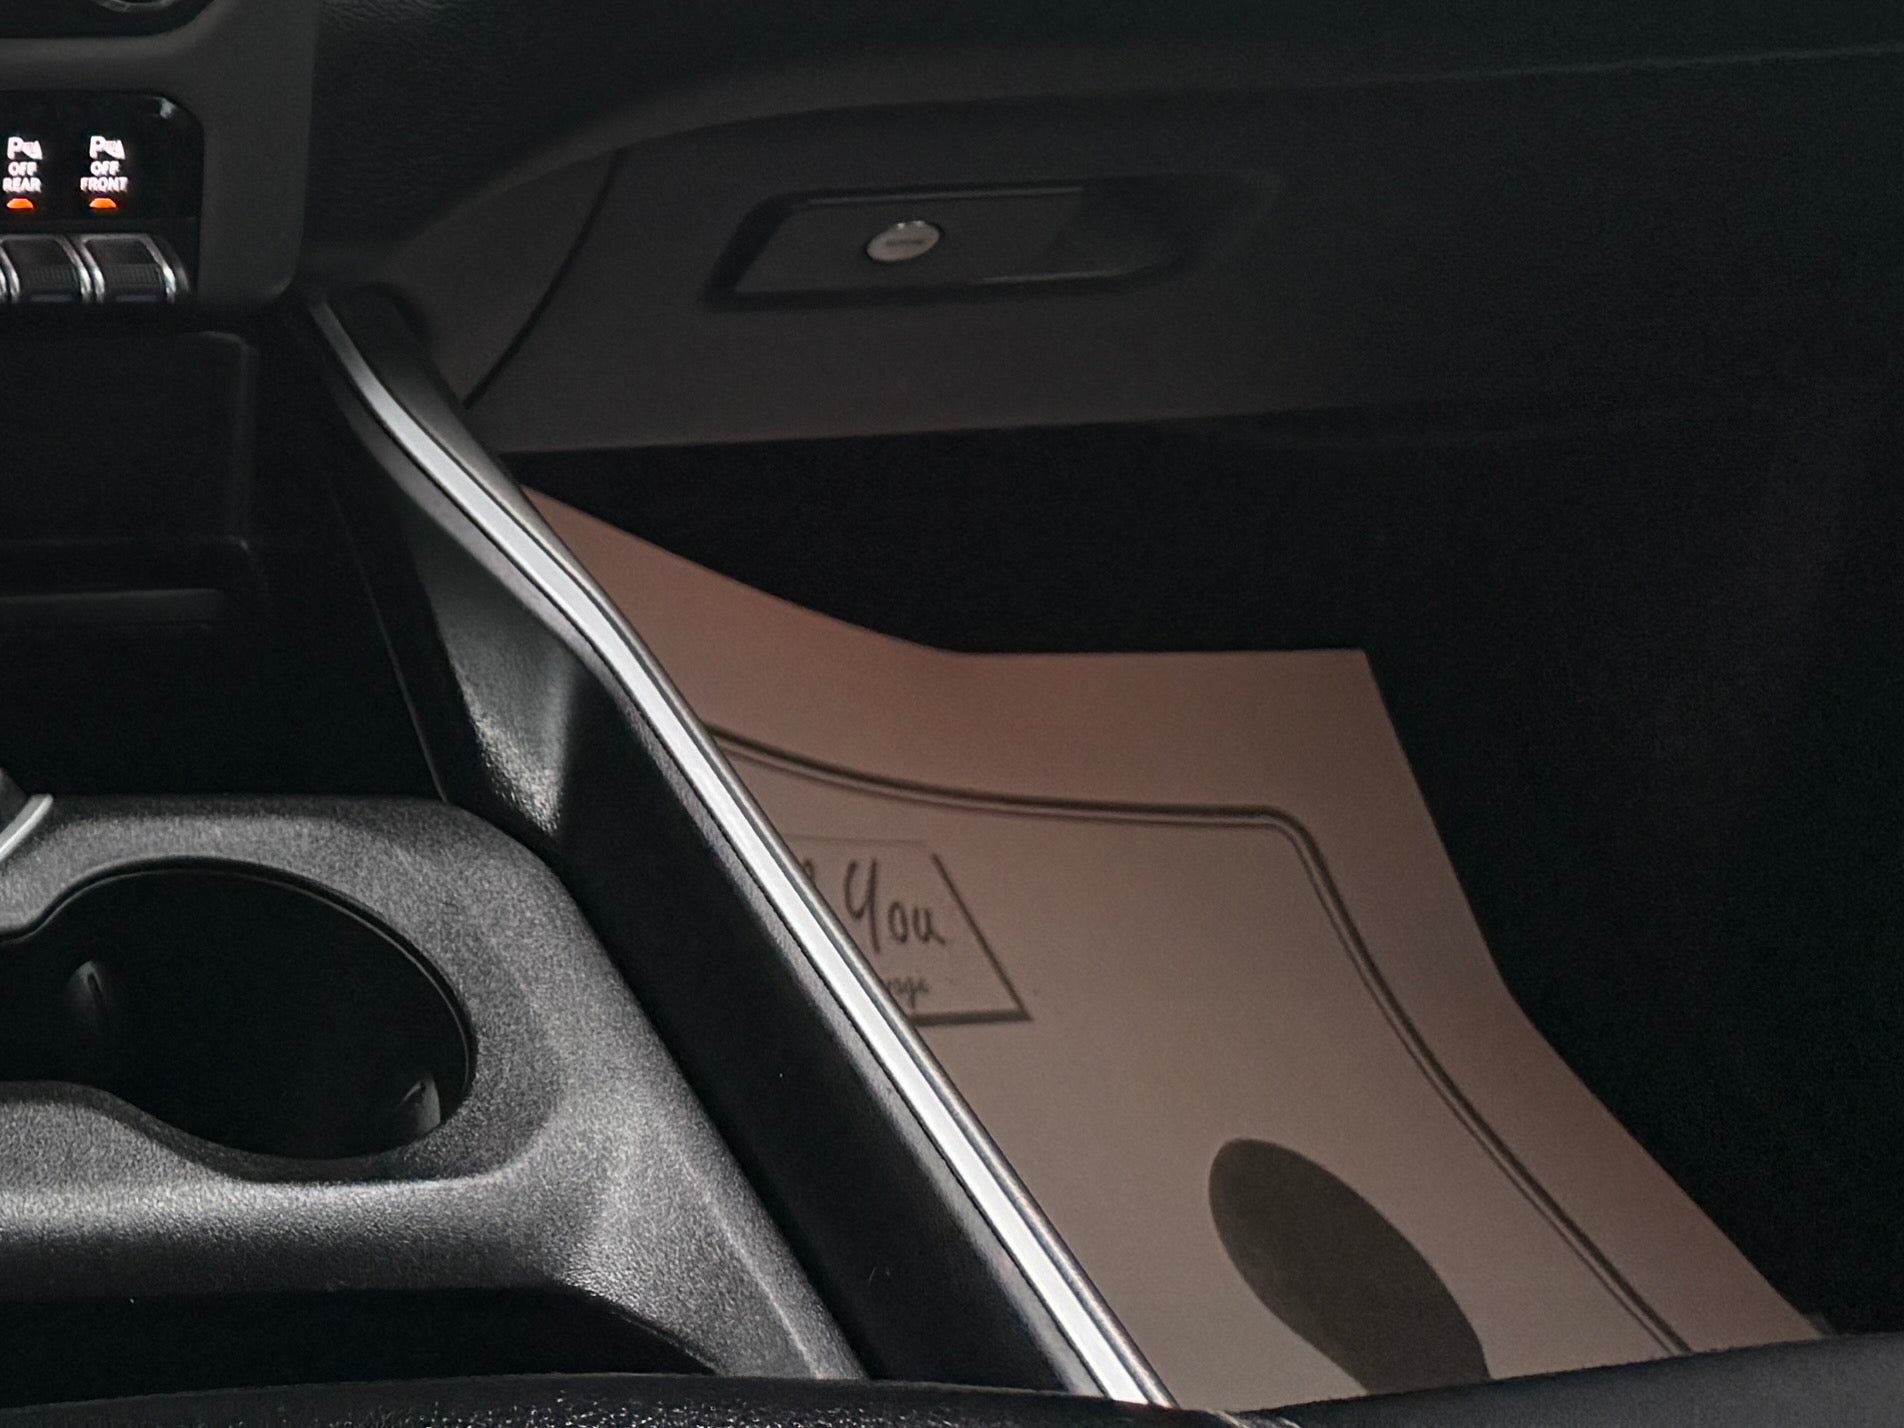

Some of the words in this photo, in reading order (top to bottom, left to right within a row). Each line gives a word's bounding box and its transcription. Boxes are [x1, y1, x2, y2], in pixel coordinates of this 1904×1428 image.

[8, 161, 37, 176] OFF
[90, 161, 118, 176] OFF
[3, 177, 41, 192] REAR
[80, 177, 128, 193] FRONT
[843, 857, 946, 955] You
